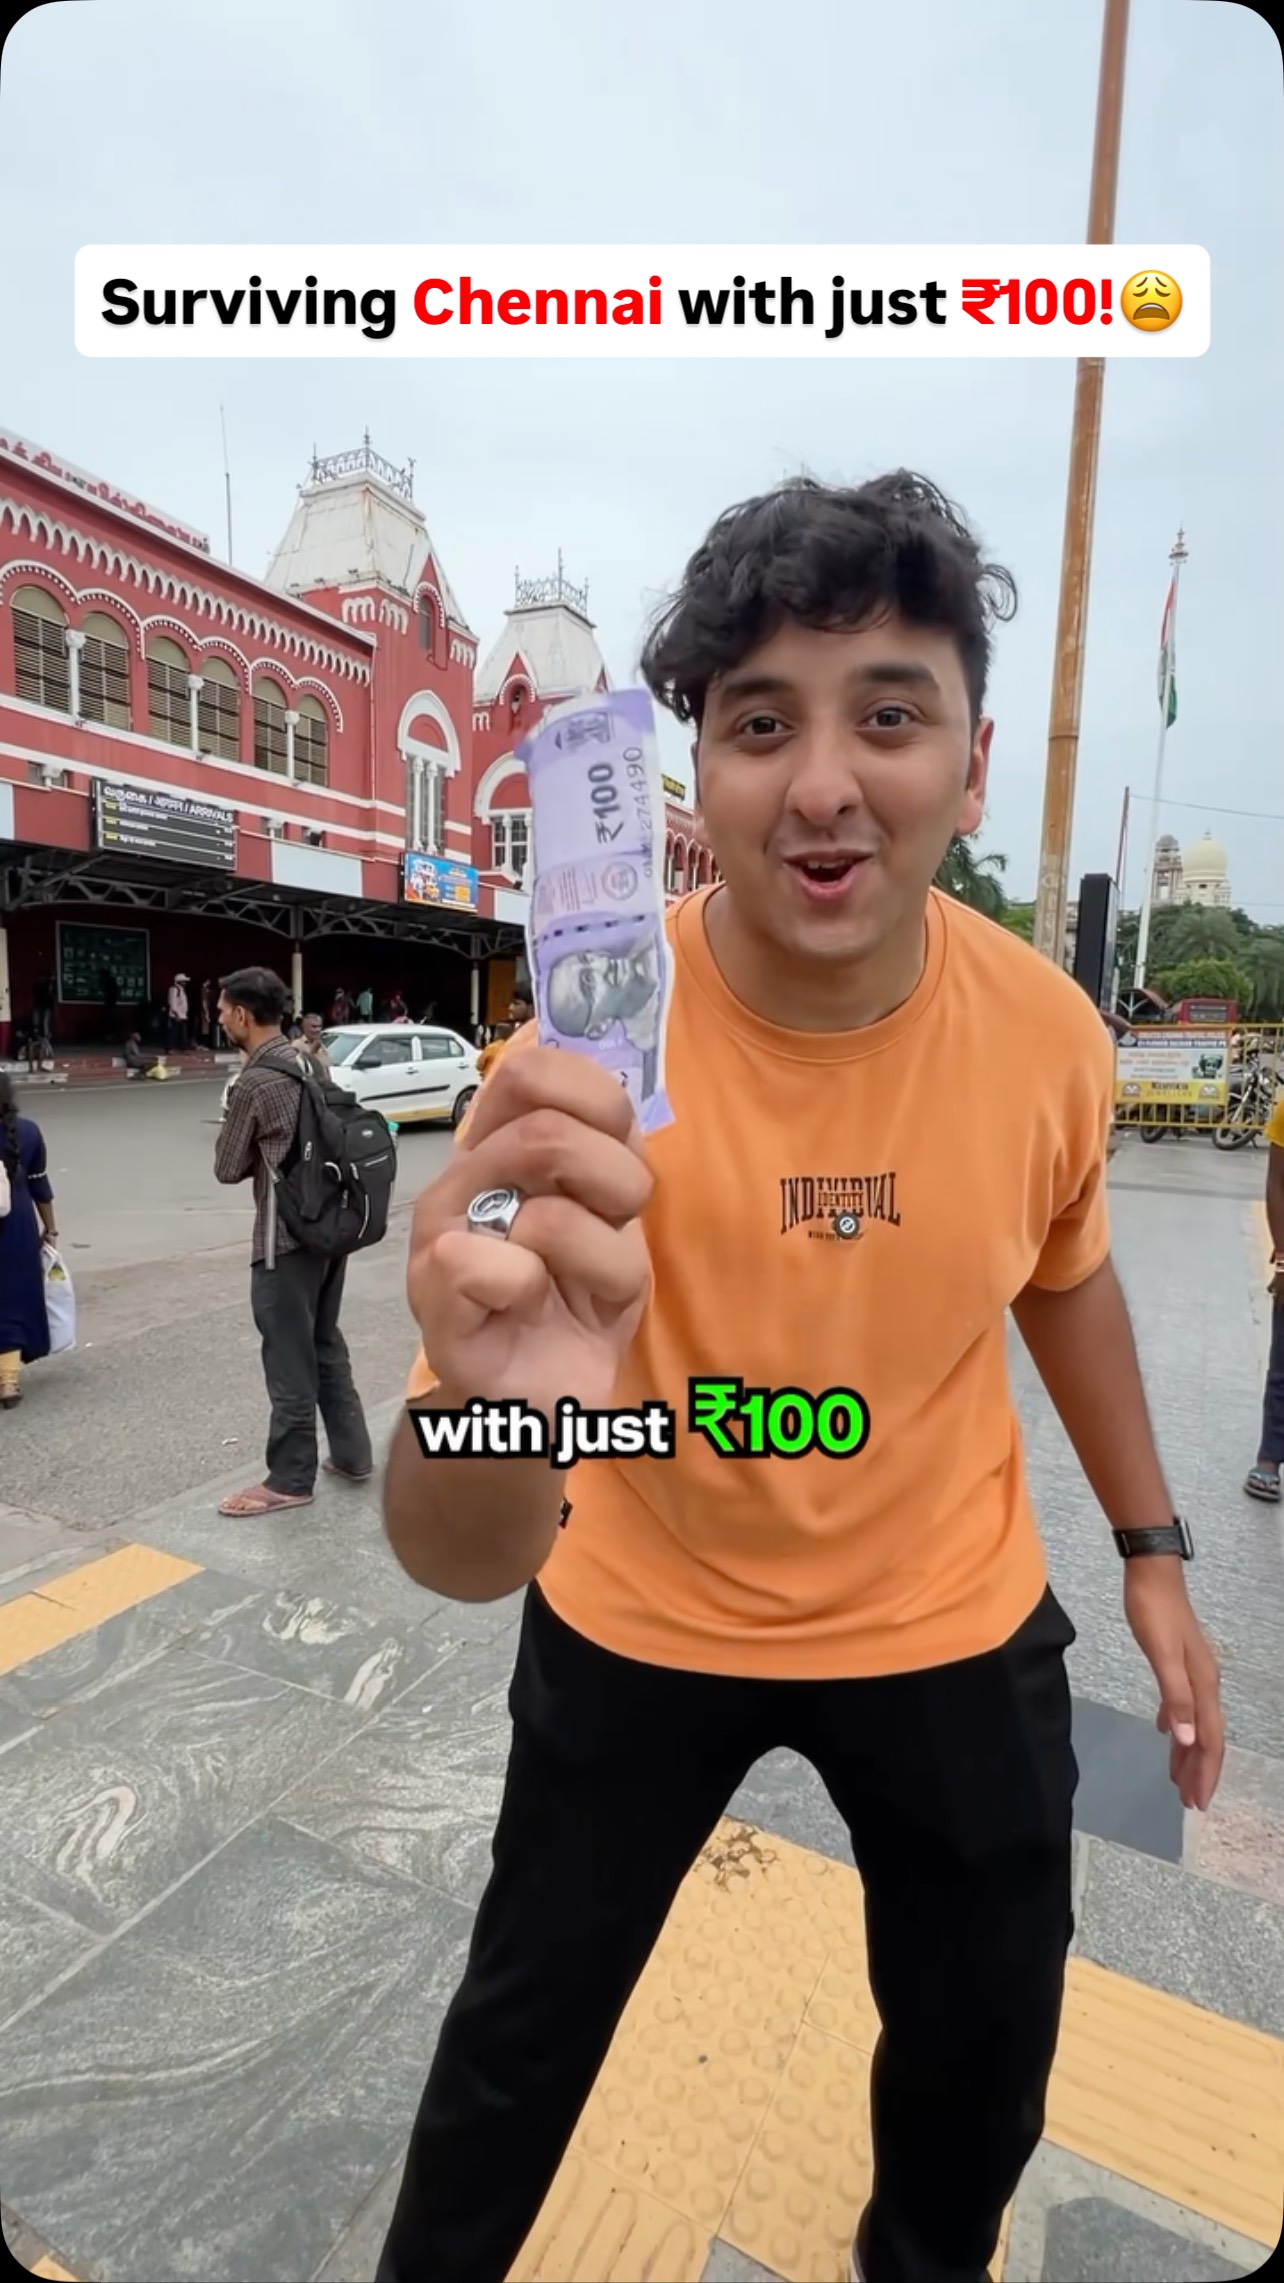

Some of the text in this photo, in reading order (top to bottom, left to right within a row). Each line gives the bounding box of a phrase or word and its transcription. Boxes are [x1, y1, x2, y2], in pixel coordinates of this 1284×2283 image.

[189, 805, 234, 823] ARRIVALS
[587, 762, 624, 844] ₹100
[622, 746, 652, 831] 274490
